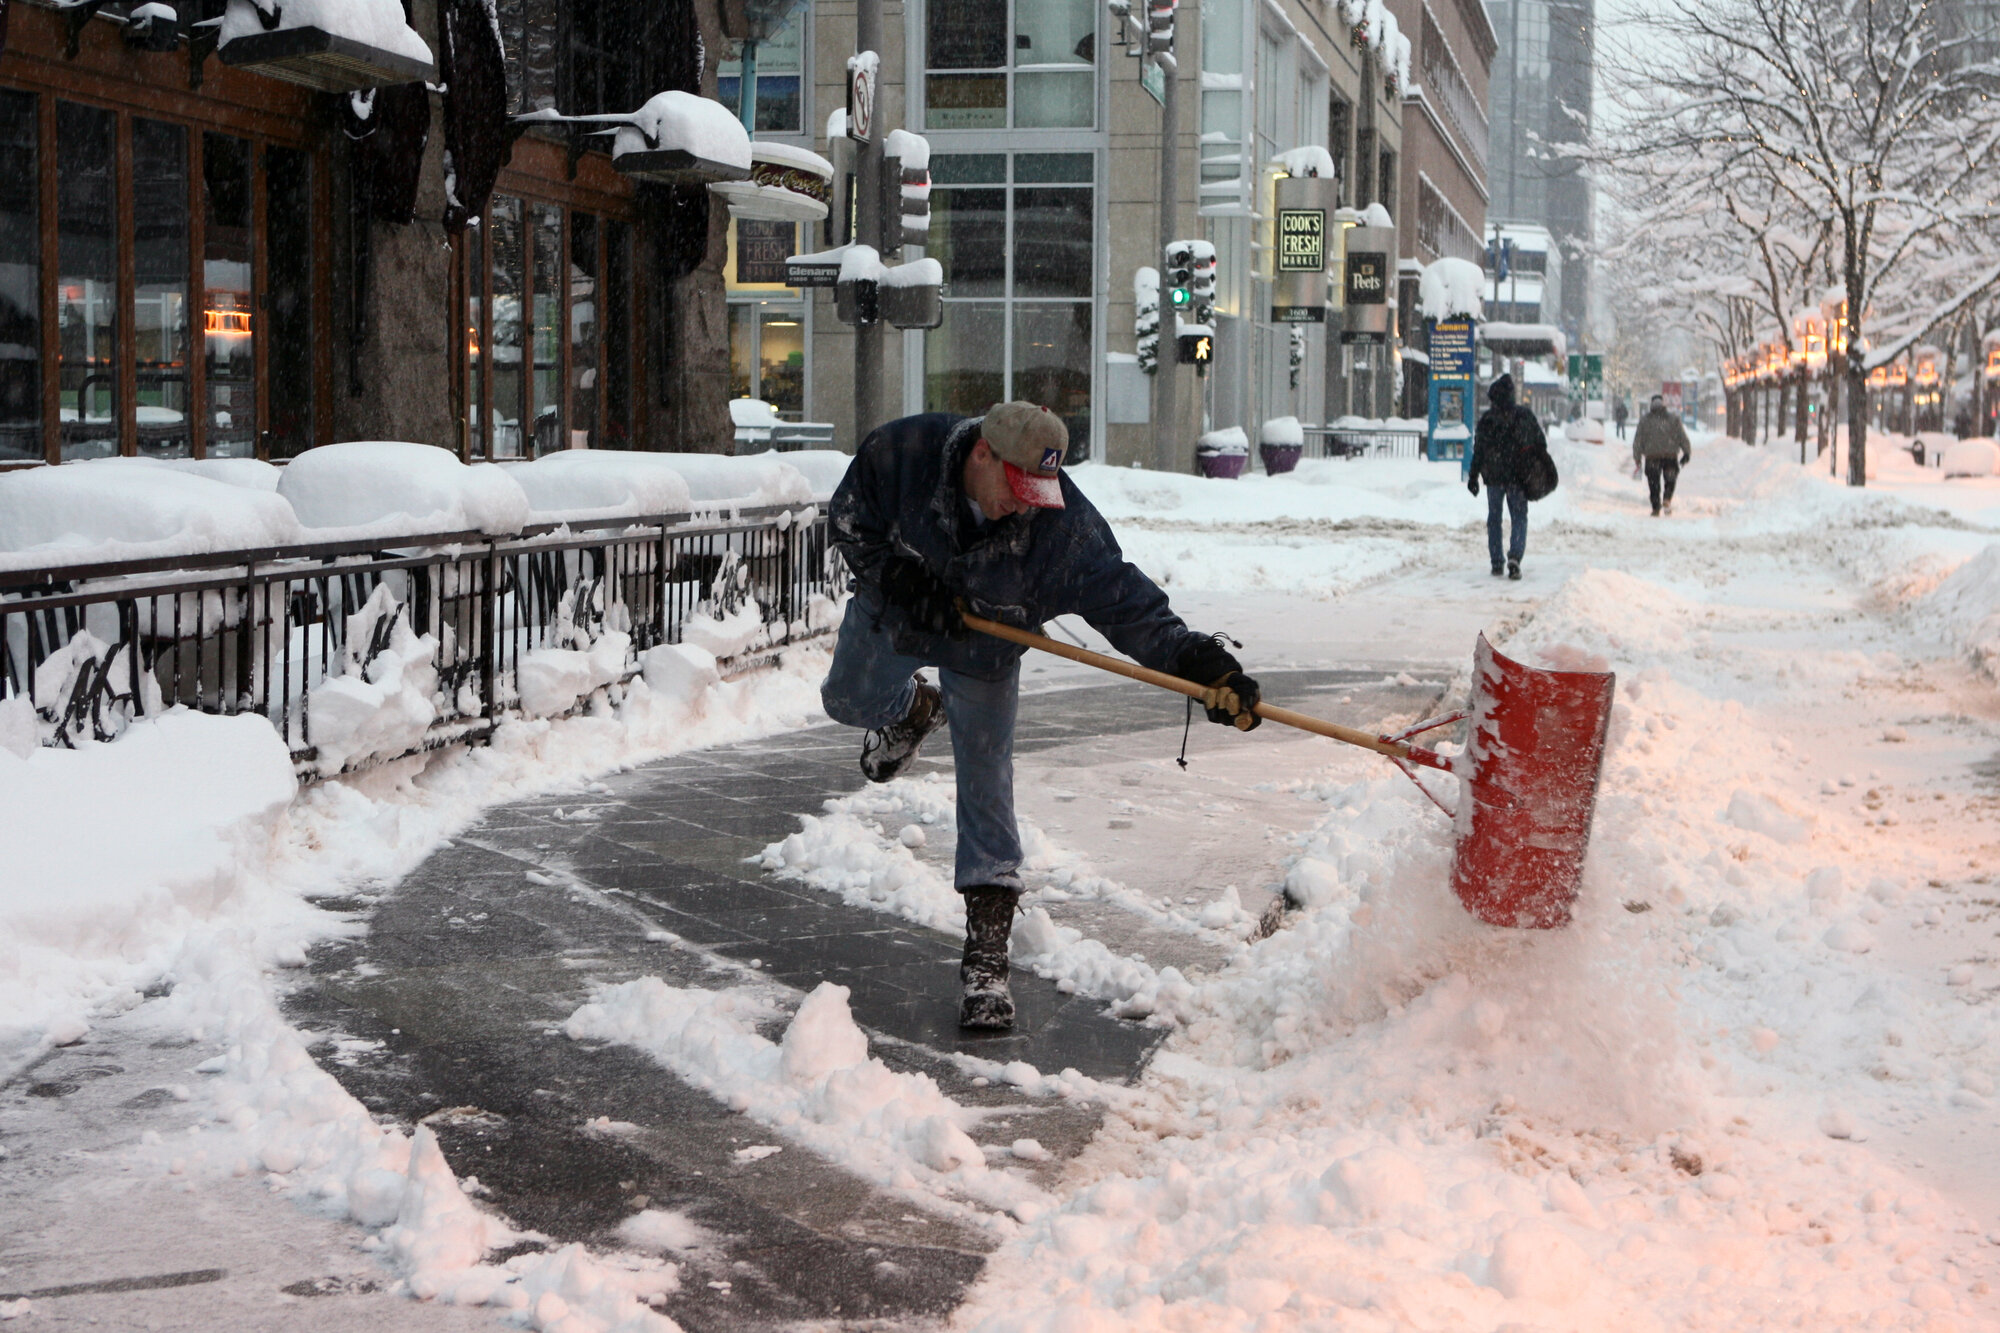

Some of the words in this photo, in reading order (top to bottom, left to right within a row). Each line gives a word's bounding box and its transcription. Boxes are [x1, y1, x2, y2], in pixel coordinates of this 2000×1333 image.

[1284, 215, 1319, 232] COOK'S
[1284, 235, 1319, 252] FRESH
[1284, 255, 1319, 265] MARKET
[789, 266, 837, 276] Glenarm
[1435, 323, 1469, 331] Glenarm
